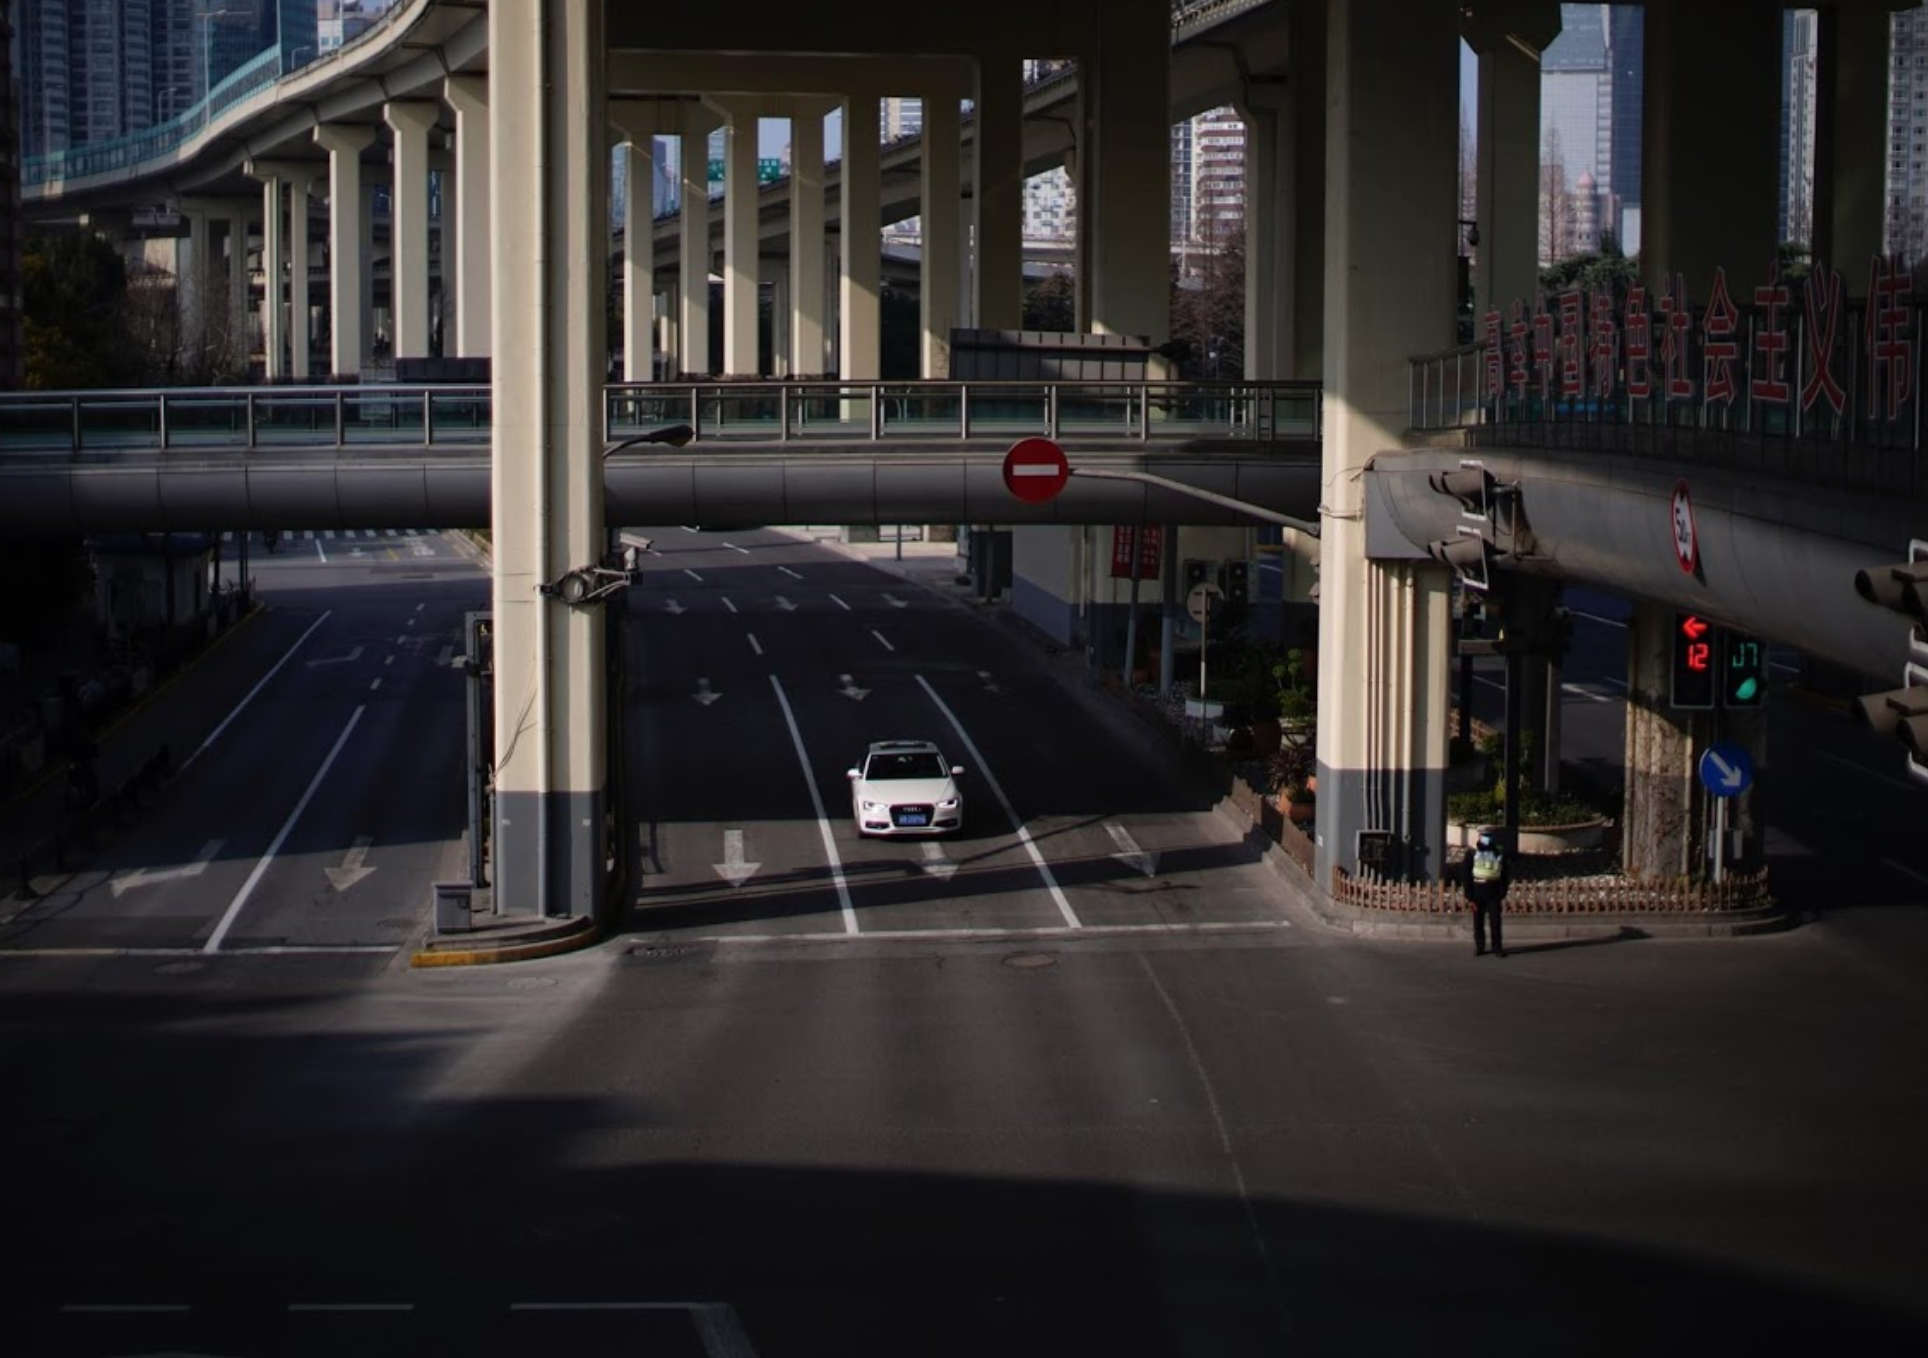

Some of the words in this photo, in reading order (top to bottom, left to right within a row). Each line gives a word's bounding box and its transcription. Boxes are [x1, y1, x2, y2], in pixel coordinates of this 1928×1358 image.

[1484, 254, 1913, 420] 高举中国特色社会主义伟
[1687, 642, 1709, 669] 12
